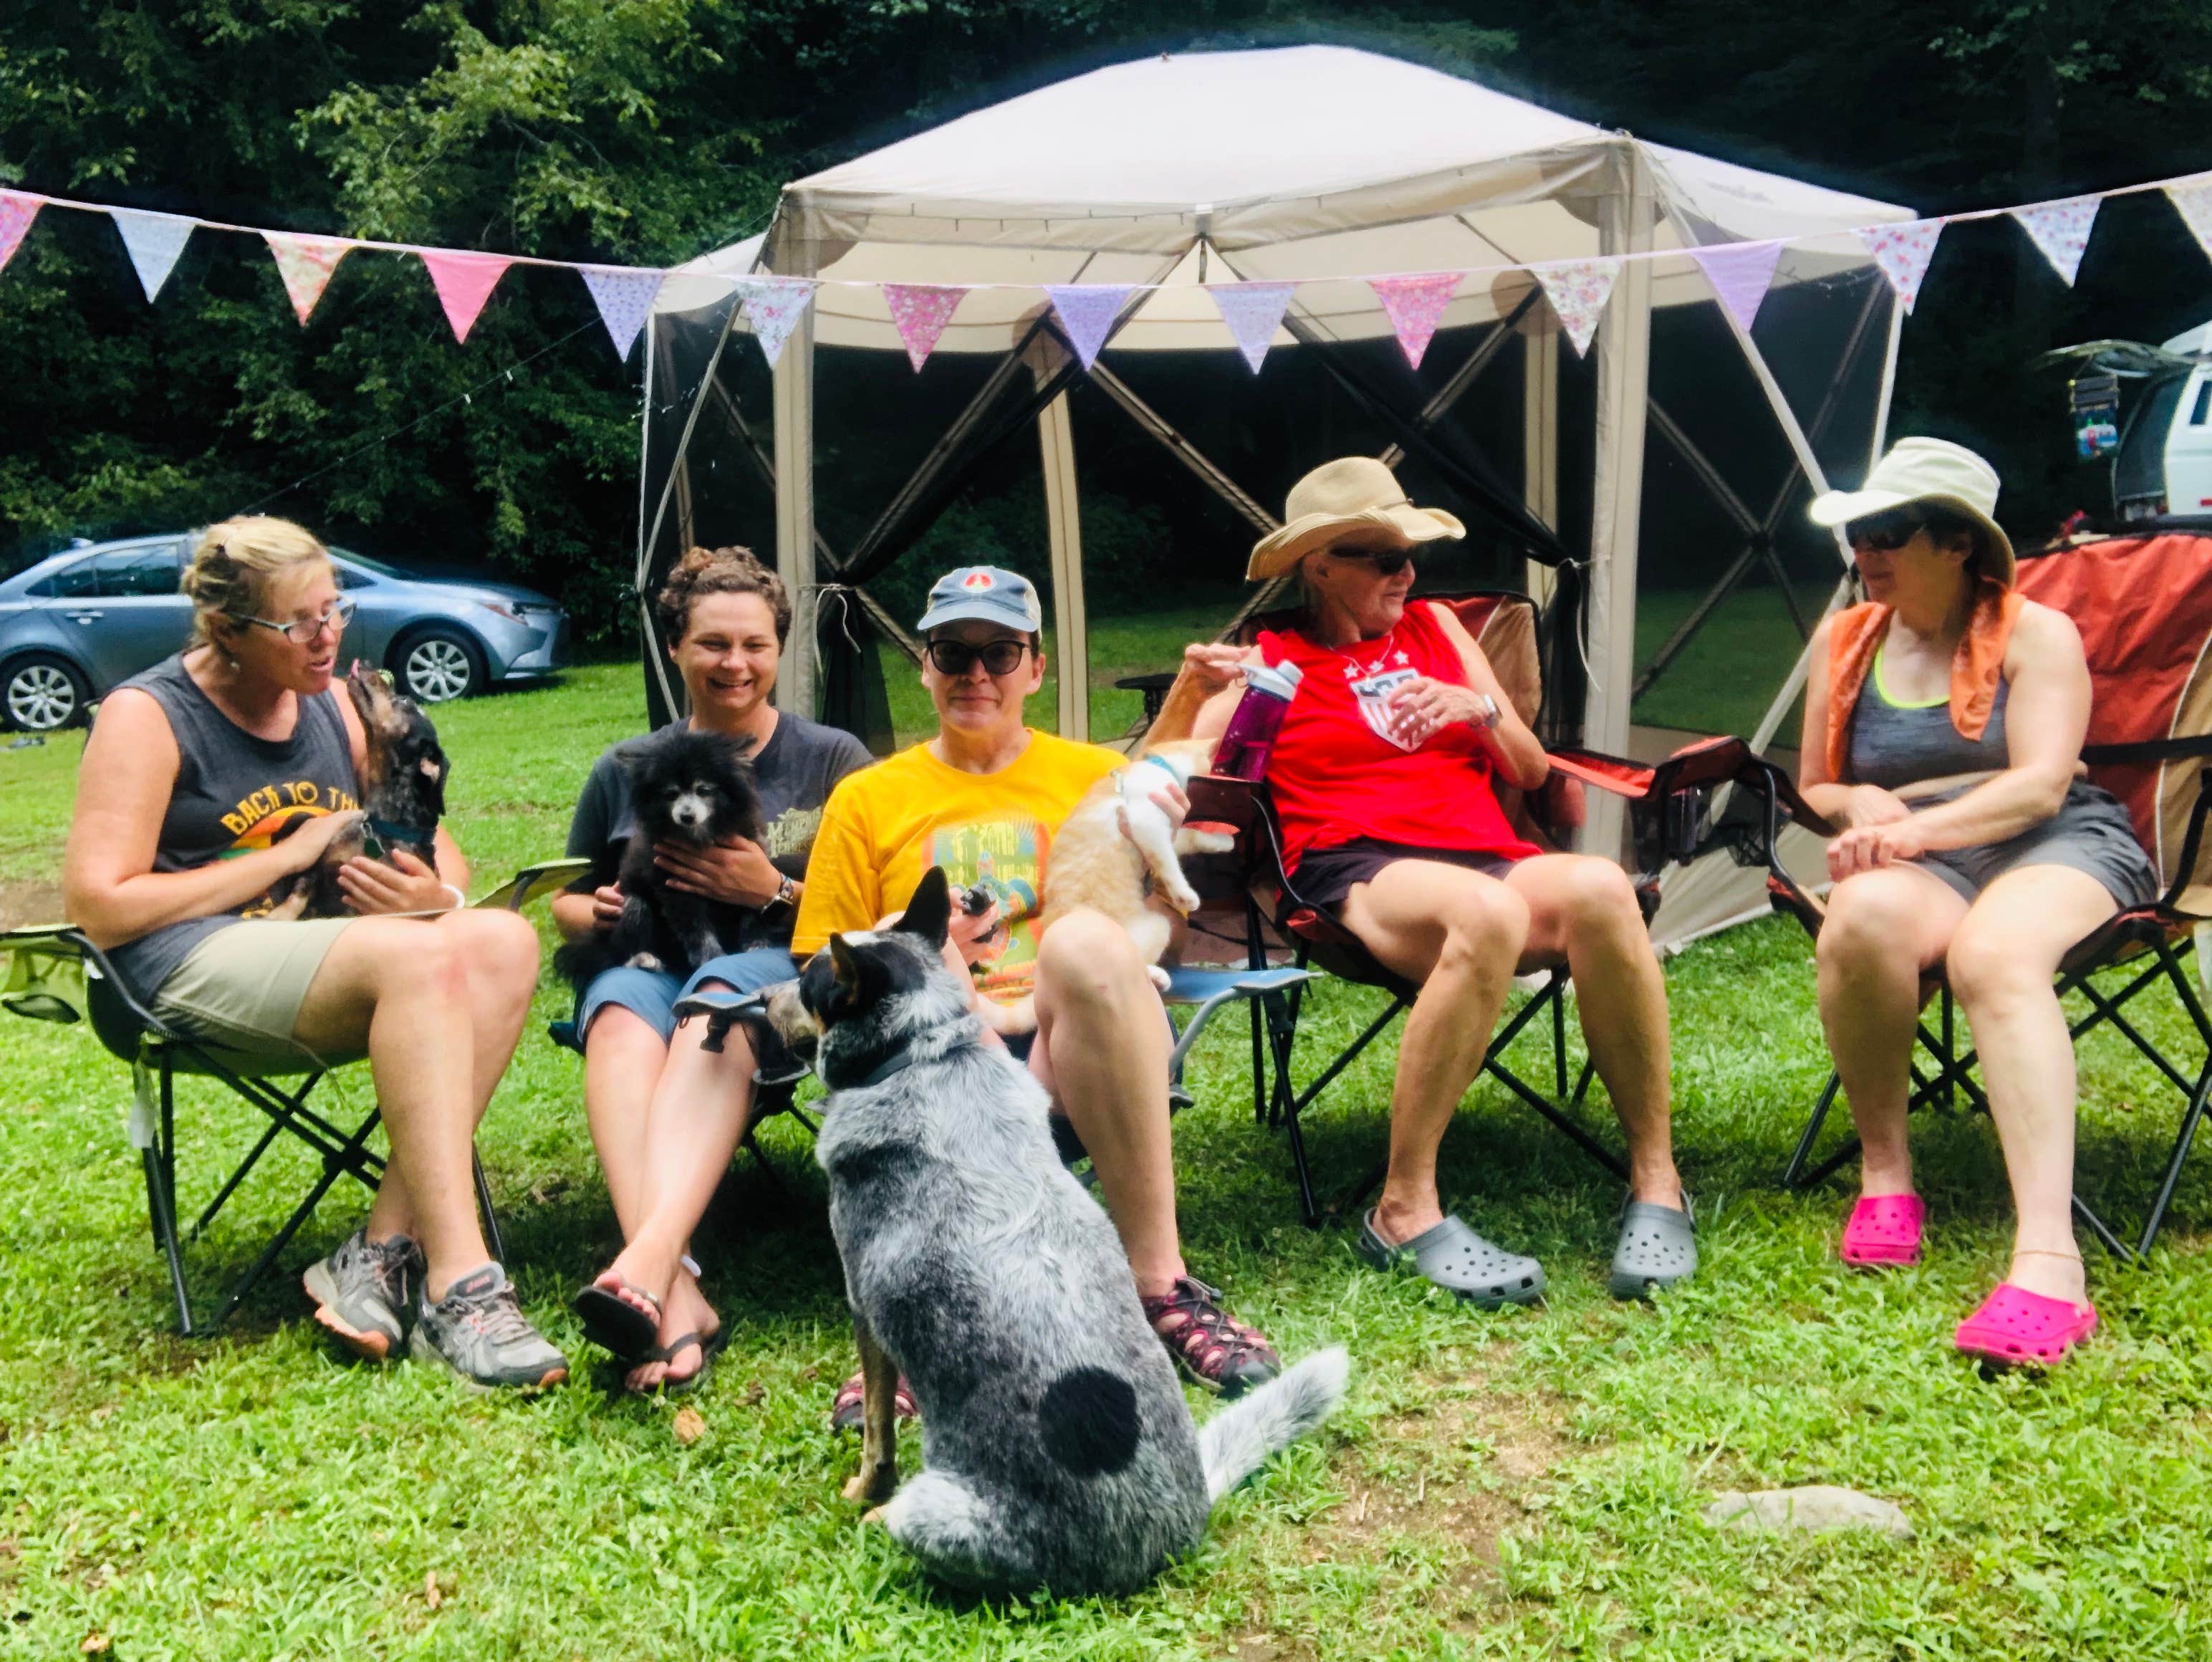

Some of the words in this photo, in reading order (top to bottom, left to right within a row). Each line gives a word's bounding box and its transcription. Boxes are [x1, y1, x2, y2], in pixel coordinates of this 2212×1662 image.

[220, 785, 282, 835] BACK
[282, 780, 319, 804] TO
[327, 786, 359, 811] TH
